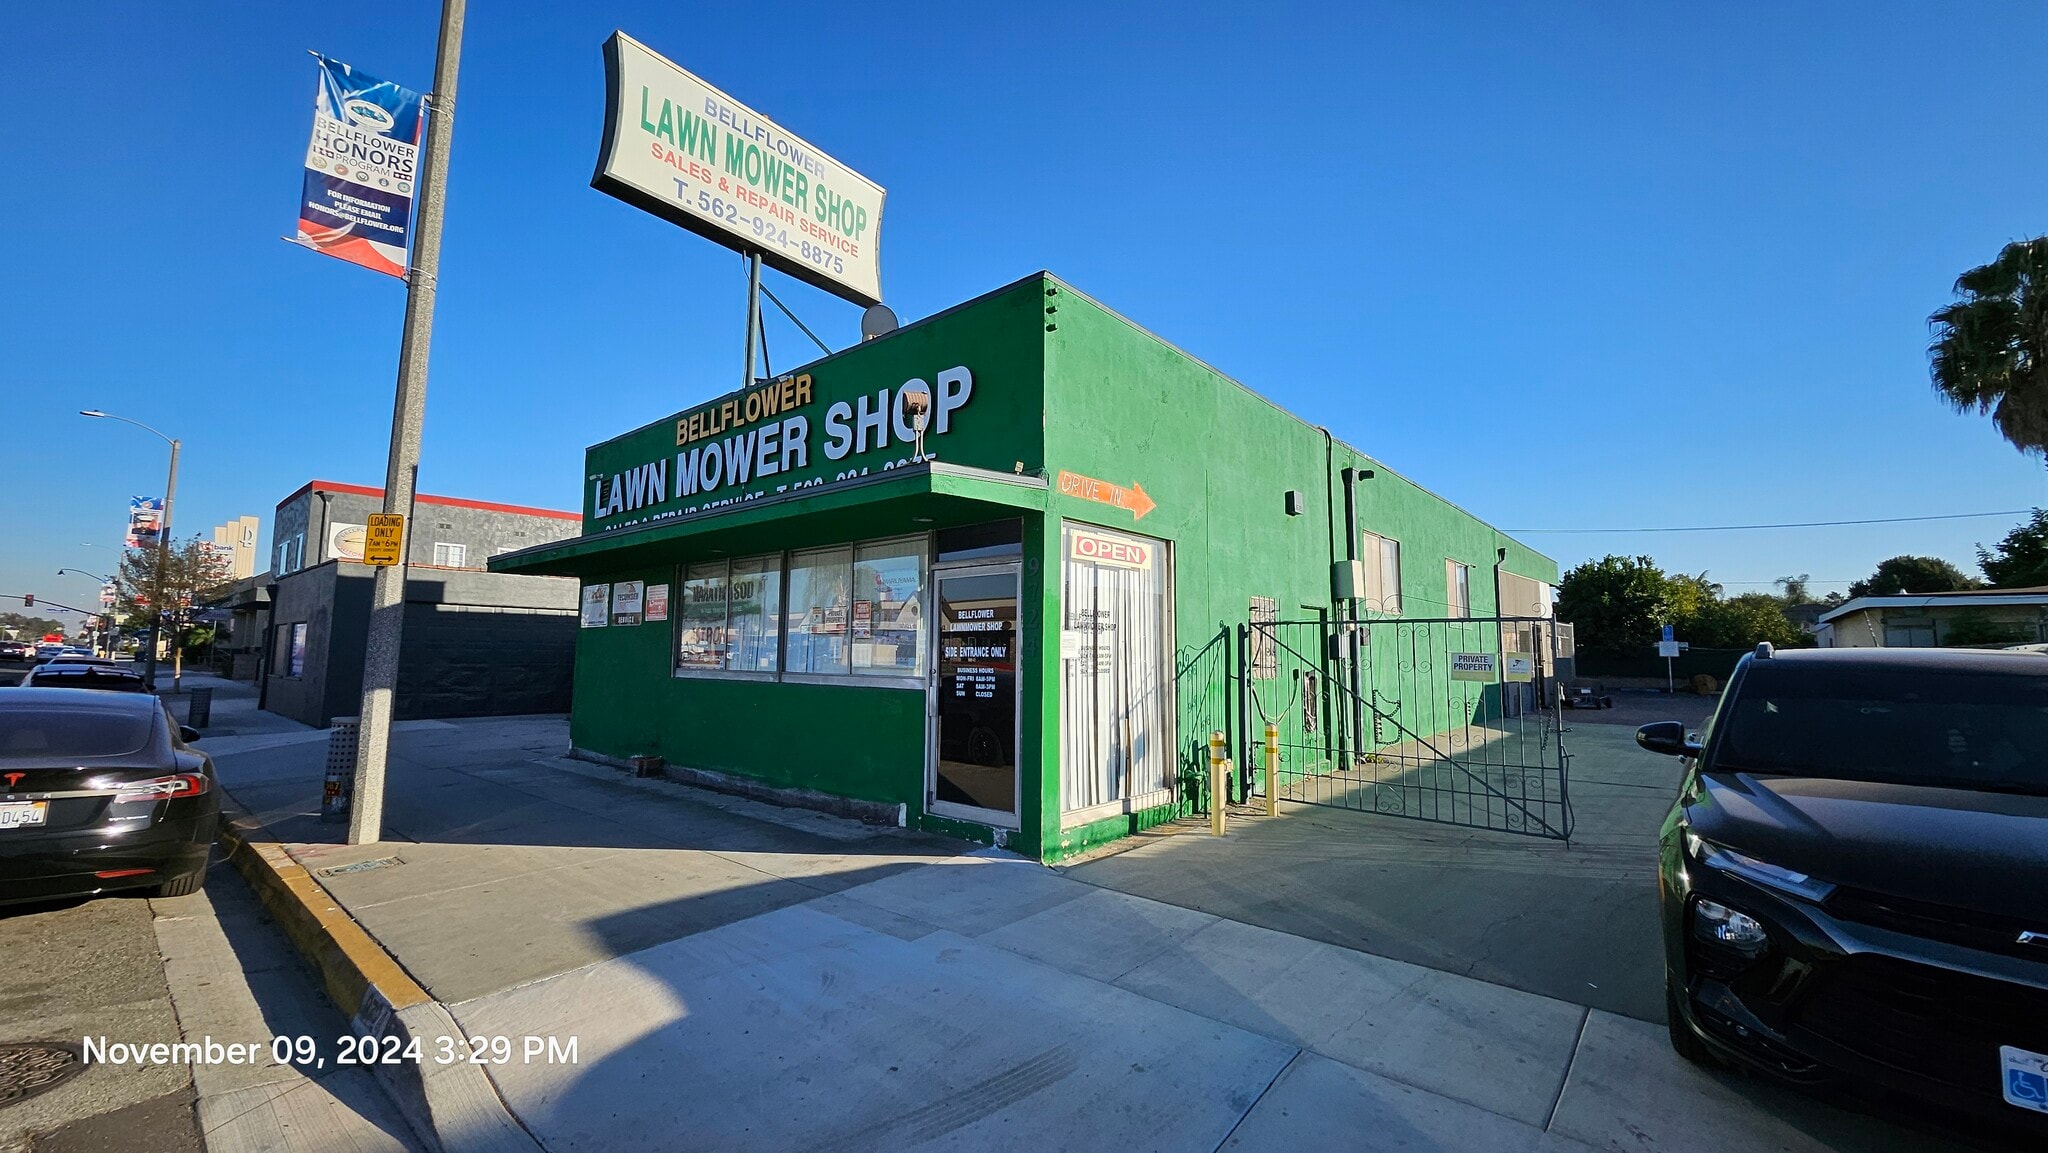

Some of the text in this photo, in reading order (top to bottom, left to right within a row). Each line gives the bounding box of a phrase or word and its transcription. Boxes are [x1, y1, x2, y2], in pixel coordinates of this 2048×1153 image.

[316, 115, 415, 158] BELLFLOWER
[704, 96, 826, 180] BELLFLOWER
[314, 128, 413, 173] HONORS
[335, 153, 390, 177] PROGRAM
[640, 85, 867, 242] LAWN MOWER SHOP
[327, 189, 391, 213] FOR INFORMATION
[334, 200, 382, 220] PLEASE EMAIL
[651, 142, 859, 259] SALES & REPAIR SERVICE
[308, 200, 404, 234] HONORS@BELLFLOWER.ORG
[672, 176, 844, 275] T. 562-924-8875
[676, 373, 813, 446] BELLFLOWER
[594, 458, 667, 519] LAWN
[675, 415, 809, 499] MOWER
[823, 365, 973, 460] SHOP
[1061, 473, 1123, 506] DRIVE IN
[370, 516, 401, 527] LOADING
[374, 528, 394, 538] ONLY
[368, 538, 381, 547] 7AM
[385, 539, 398, 547] 6PM
[1078, 538, 1140, 563] OPEN
[949, 621, 1003, 632] LAWNMOWER SHOP
[958, 609, 995, 620] BELLFLOWER
[944, 646, 1007, 658] SIDE ENTRANCE ONLY
[1458, 655, 1489, 664] PRIVATE
[1453, 663, 1493, 671] PROPERTY
